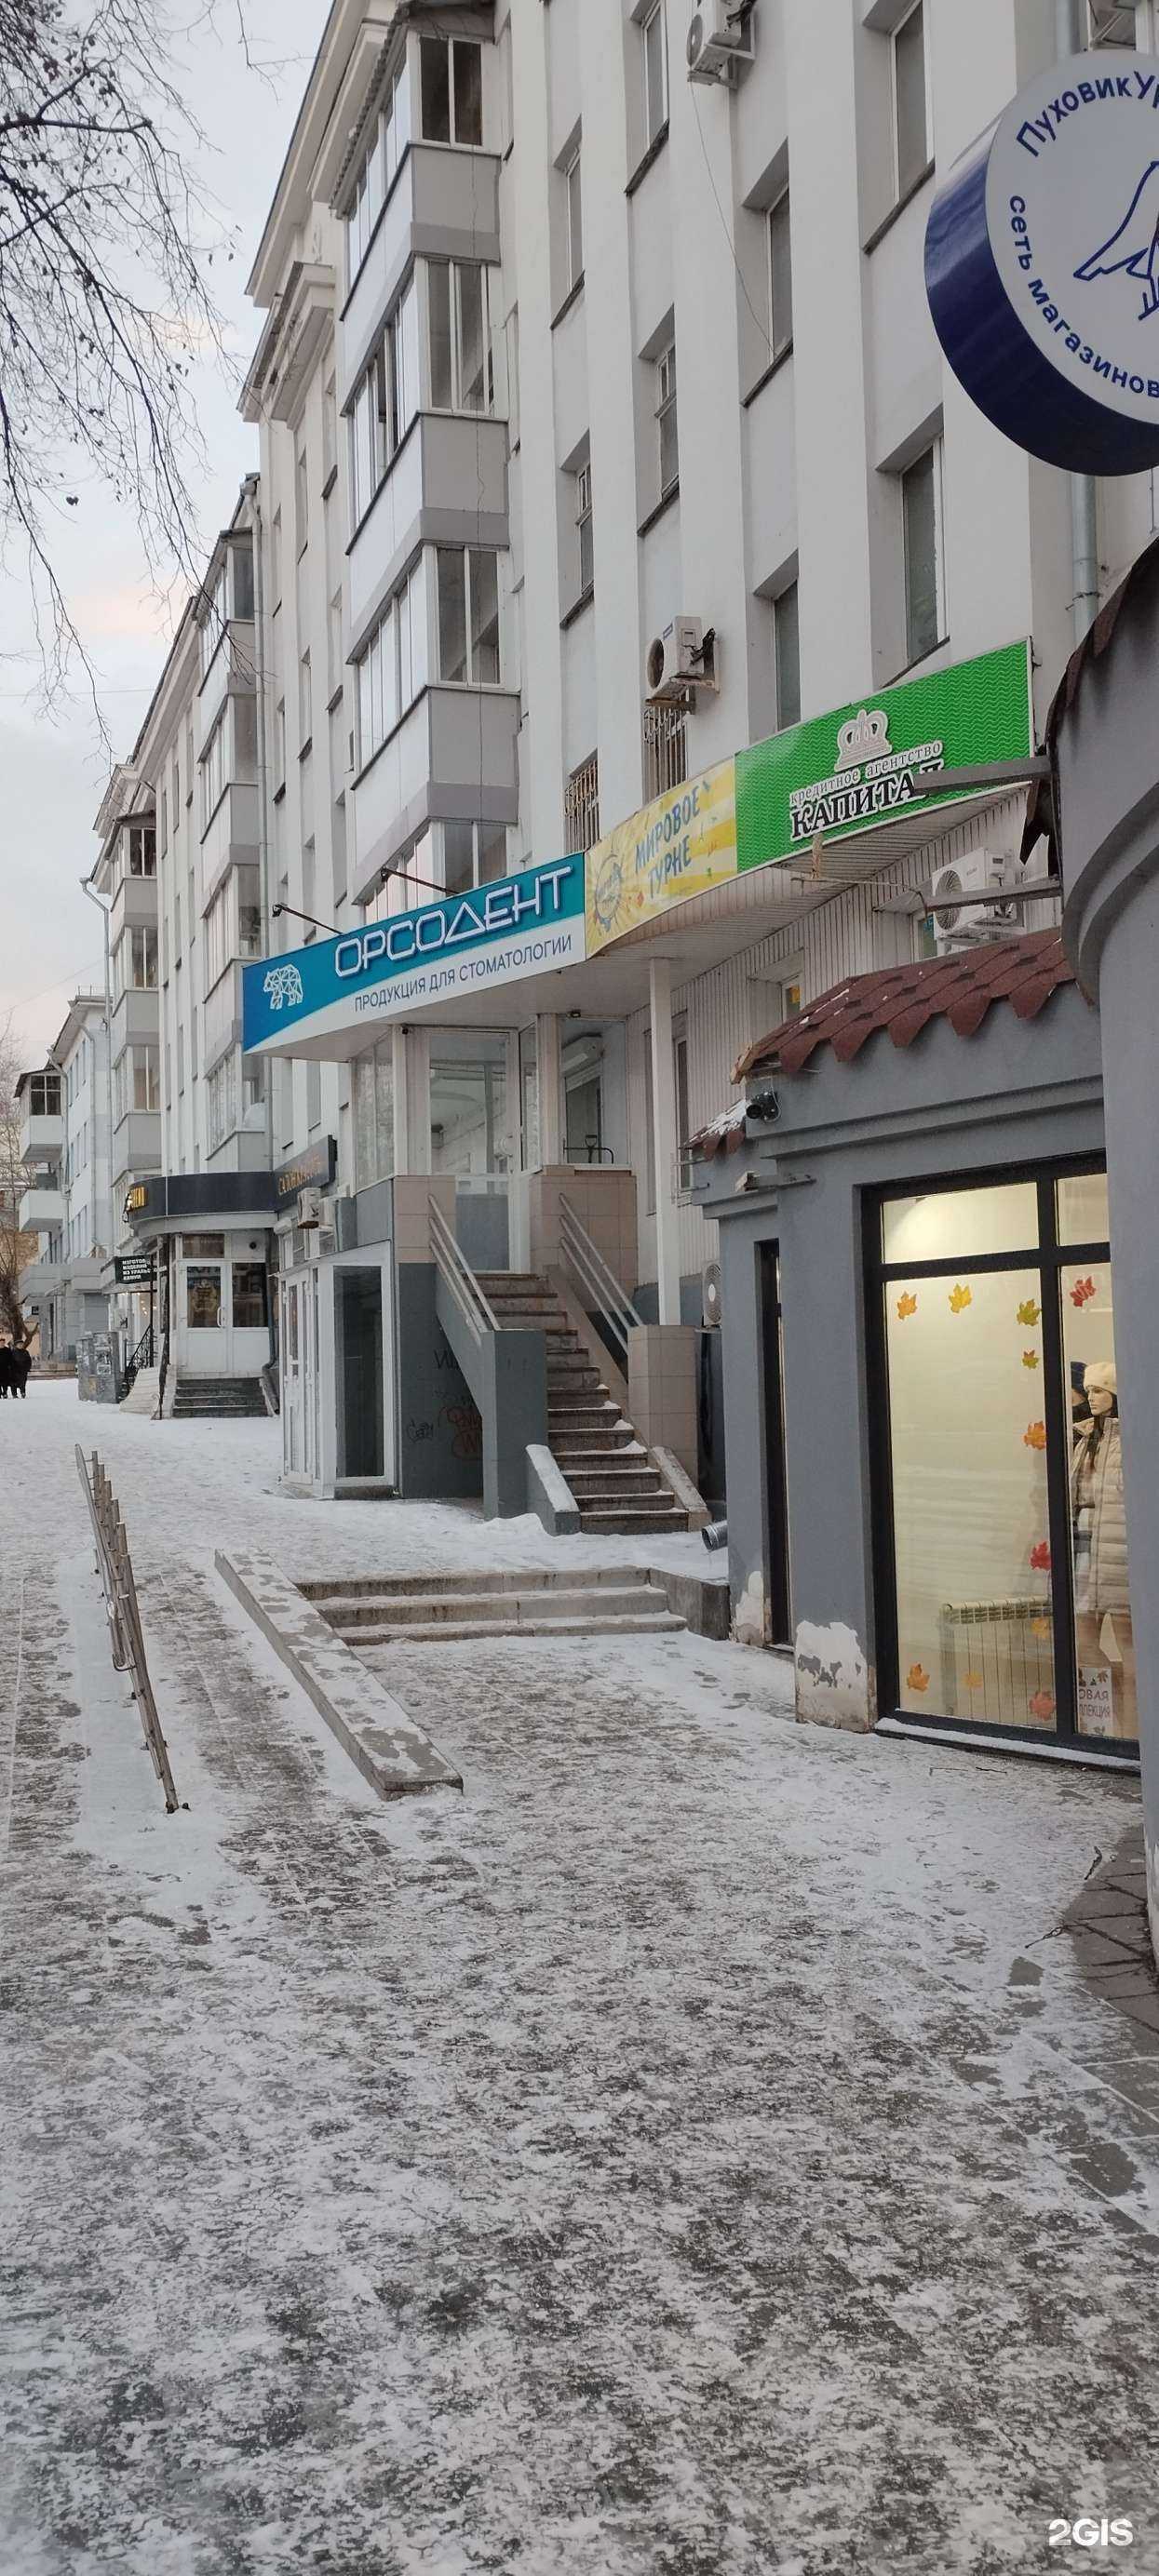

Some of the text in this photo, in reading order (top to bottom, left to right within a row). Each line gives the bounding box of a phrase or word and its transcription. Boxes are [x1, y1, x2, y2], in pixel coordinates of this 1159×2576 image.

[1009, 195, 1031, 271] сеть
[790, 742, 941, 806] кредитное агентство
[635, 785, 702, 875] МИРОВОЕ
[648, 835, 692, 899] ТУРНЕ
[334, 865, 573, 978] ОРСОДЕНТ
[354, 933, 573, 1013] ПРОДУКЦИЯ ДЛЯ СТОМАТОЛОГИИ
[1078, 1688, 1109, 1700] ОВАЯ
